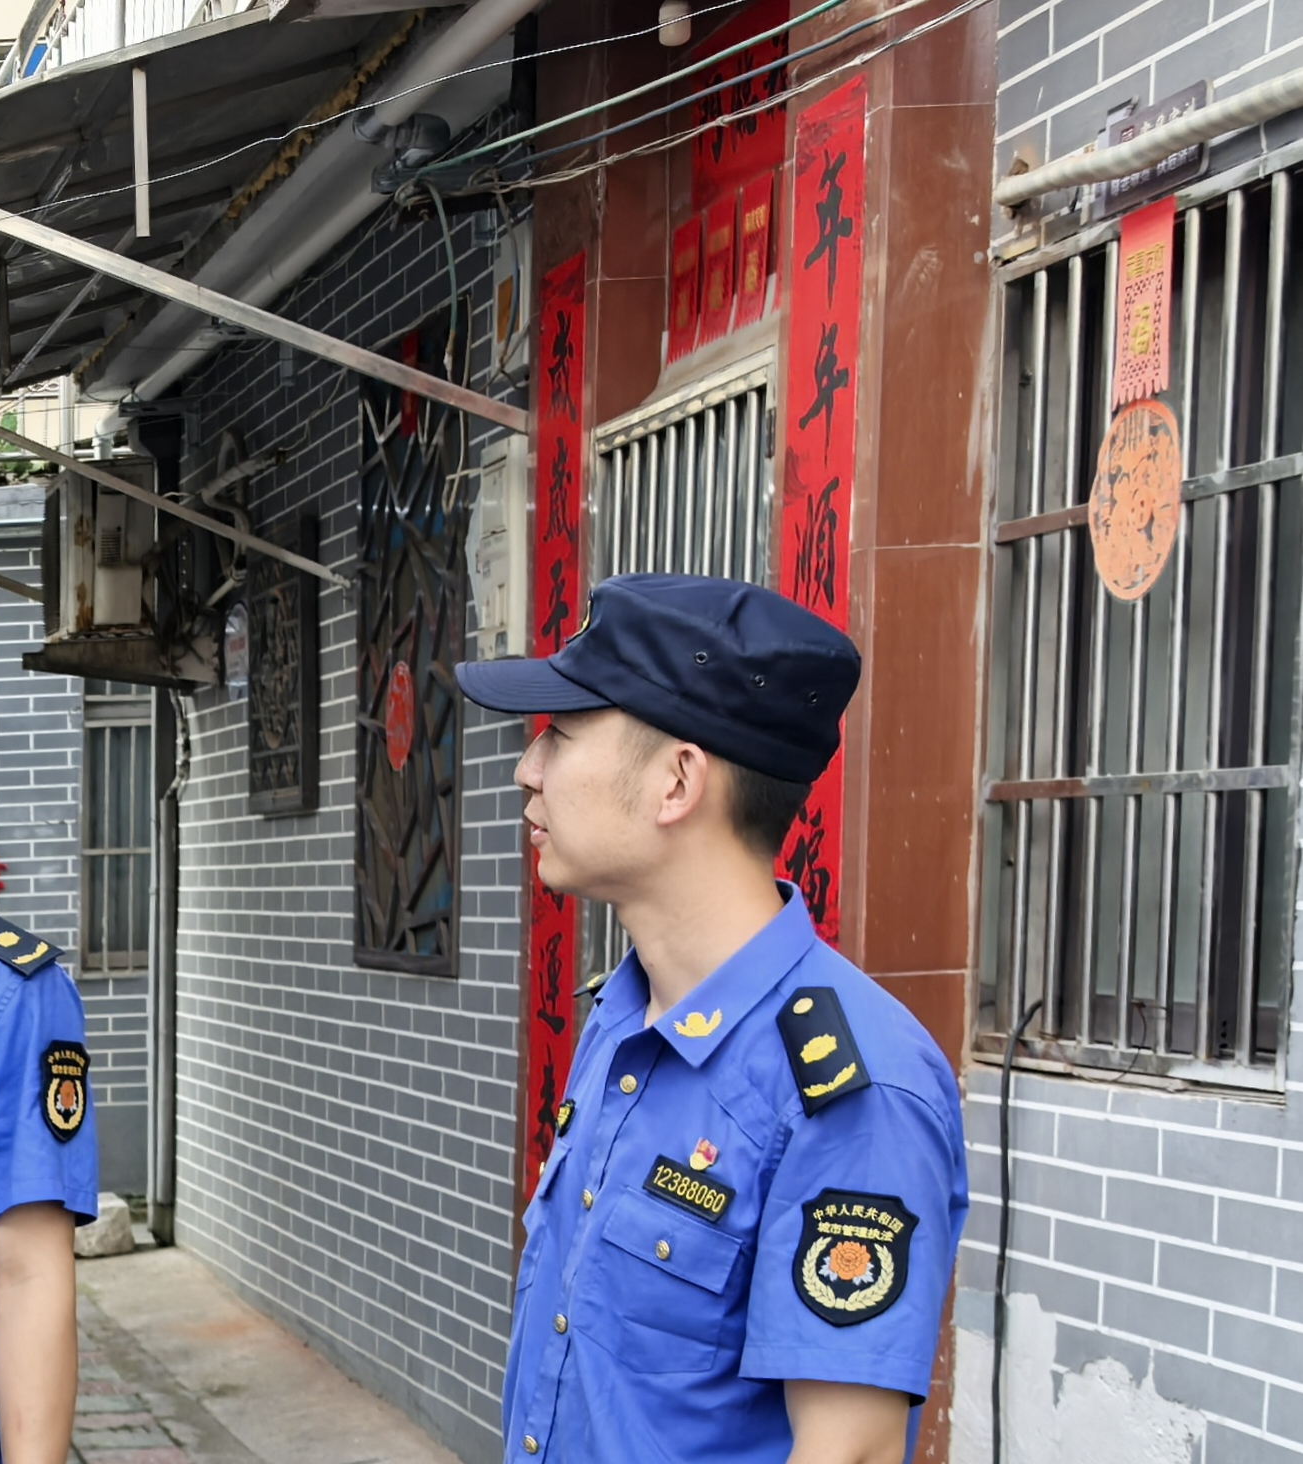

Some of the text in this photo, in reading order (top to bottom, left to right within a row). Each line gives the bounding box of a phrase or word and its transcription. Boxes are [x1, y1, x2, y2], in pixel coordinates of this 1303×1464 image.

[653, 1165, 726, 1214] 12388060
[812, 1203, 905, 1235] 中华人民共和国
[817, 1220, 895, 1243] 城市管理执法
